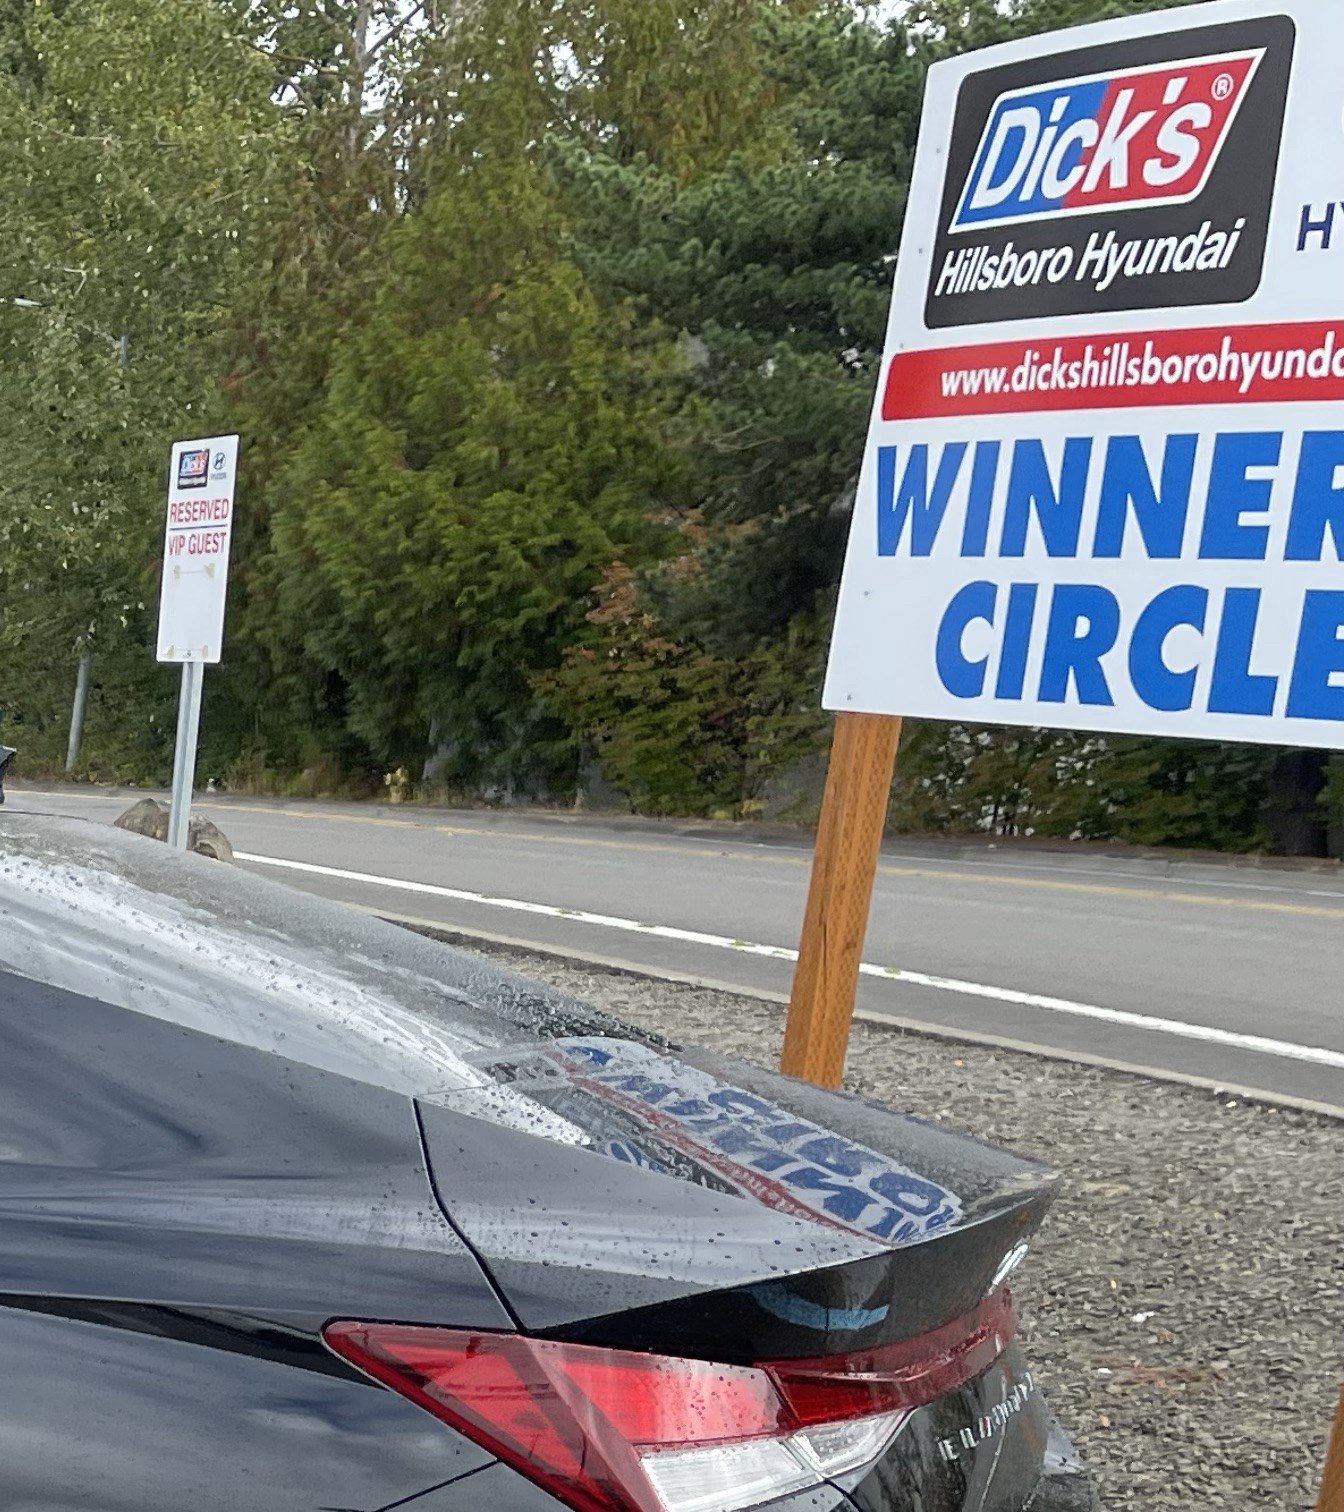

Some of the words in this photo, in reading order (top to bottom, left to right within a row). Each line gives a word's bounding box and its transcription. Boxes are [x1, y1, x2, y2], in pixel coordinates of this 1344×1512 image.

[970, 77, 1213, 210] Dick's
[935, 243, 1073, 297] Hillsboro
[1075, 217, 1246, 291] Hyundai
[1296, 201, 1344, 251] H
[170, 498, 229, 523] RESERVED
[878, 431, 1344, 561] WINNER
[168, 534, 186, 555] VIP
[188, 532, 226, 555] GUEST
[935, 580, 1344, 721] CIRCLE
